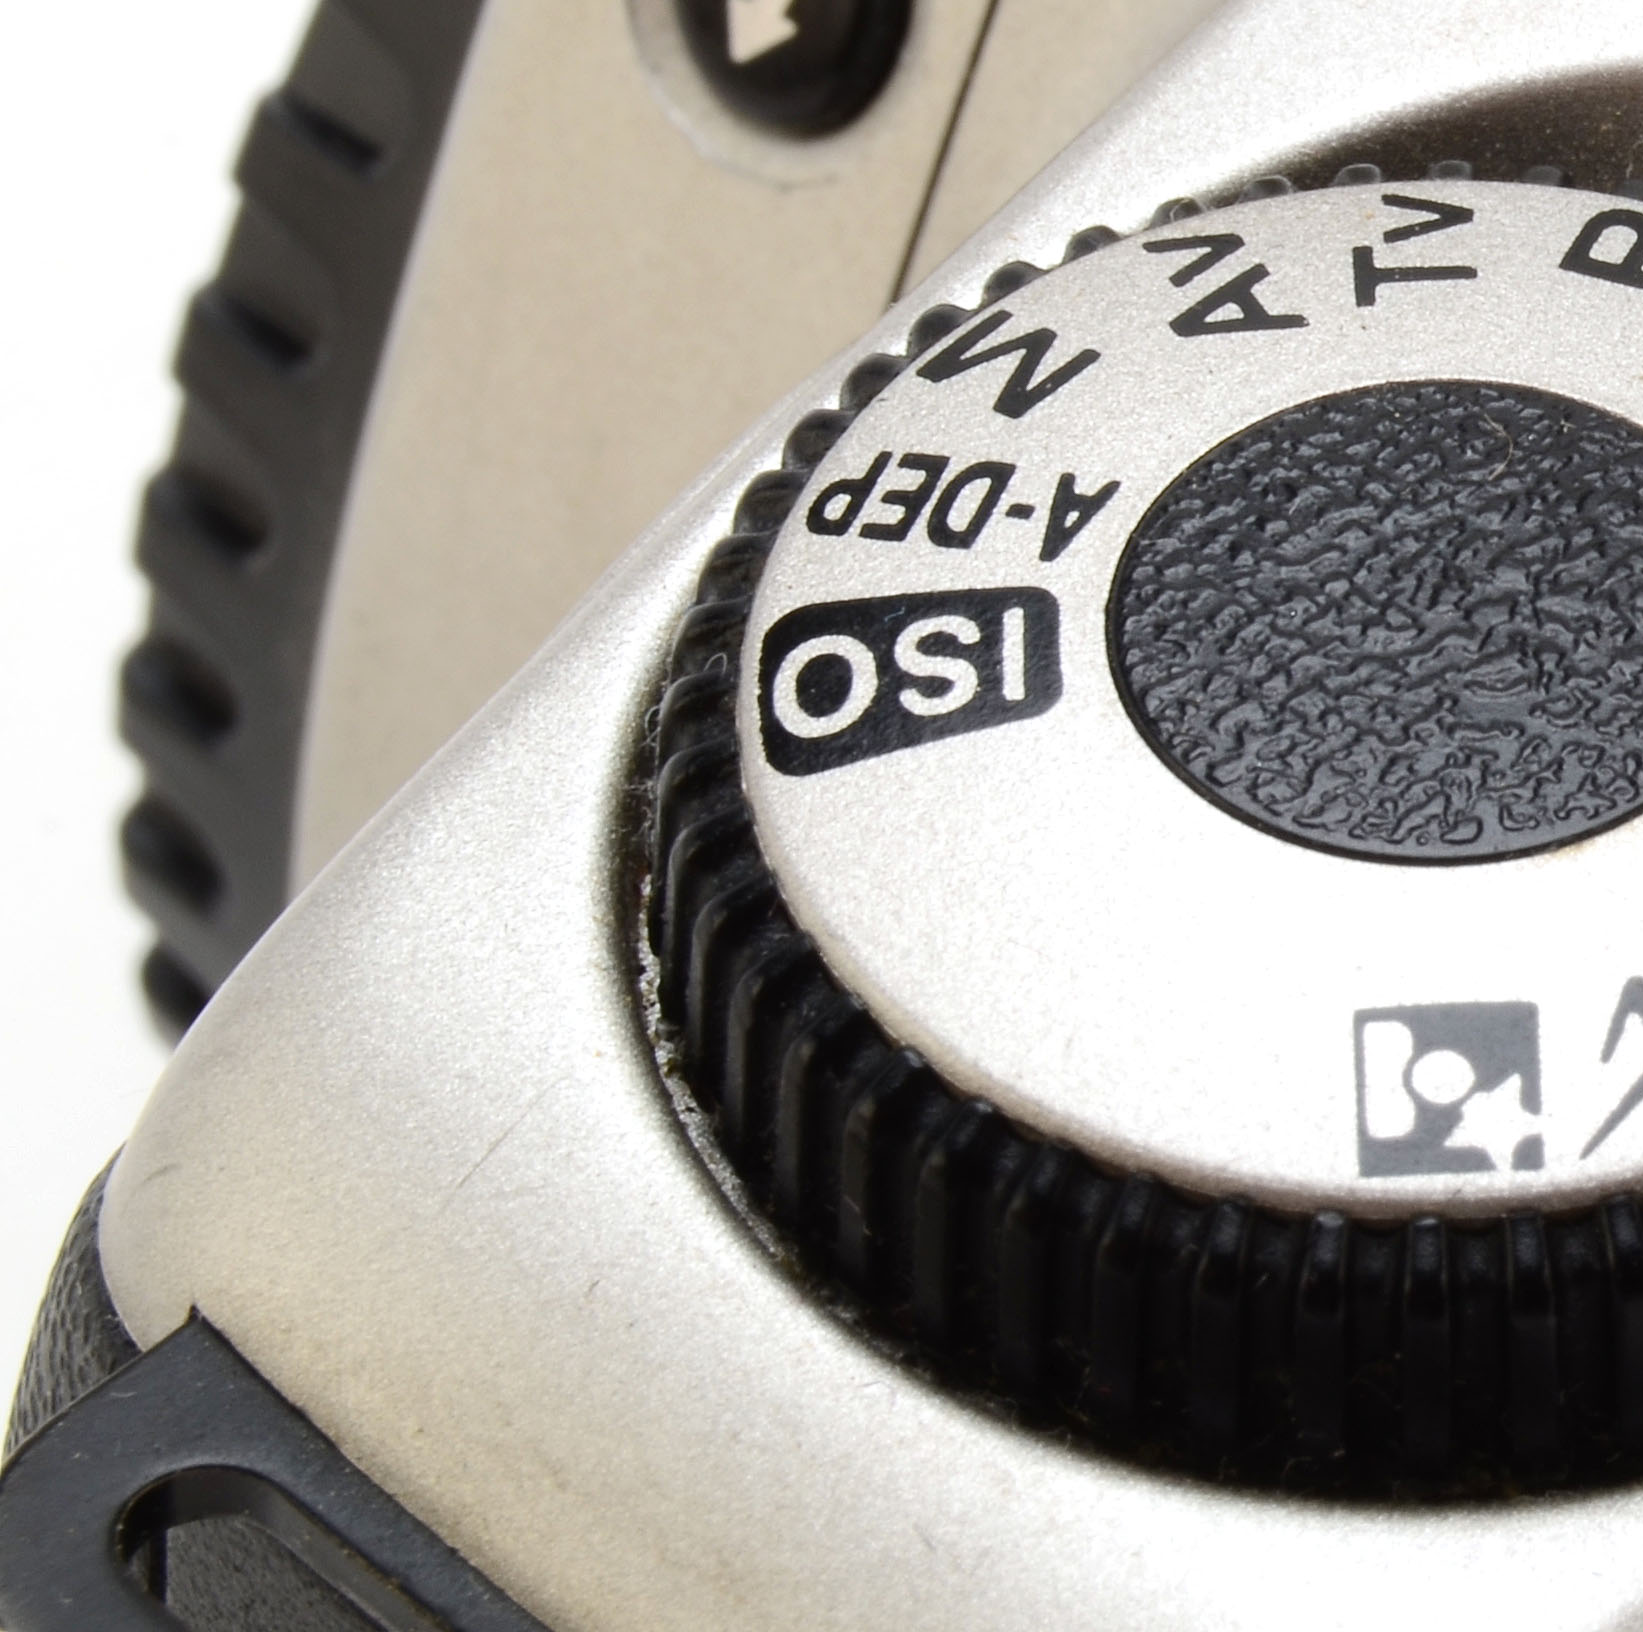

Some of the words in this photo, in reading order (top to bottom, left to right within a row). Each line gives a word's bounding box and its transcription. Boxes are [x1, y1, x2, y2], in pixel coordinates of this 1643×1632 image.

[916, 310, 1101, 419] M
[806, 451, 1121, 562] A-DEP
[773, 606, 1025, 739] ISO
